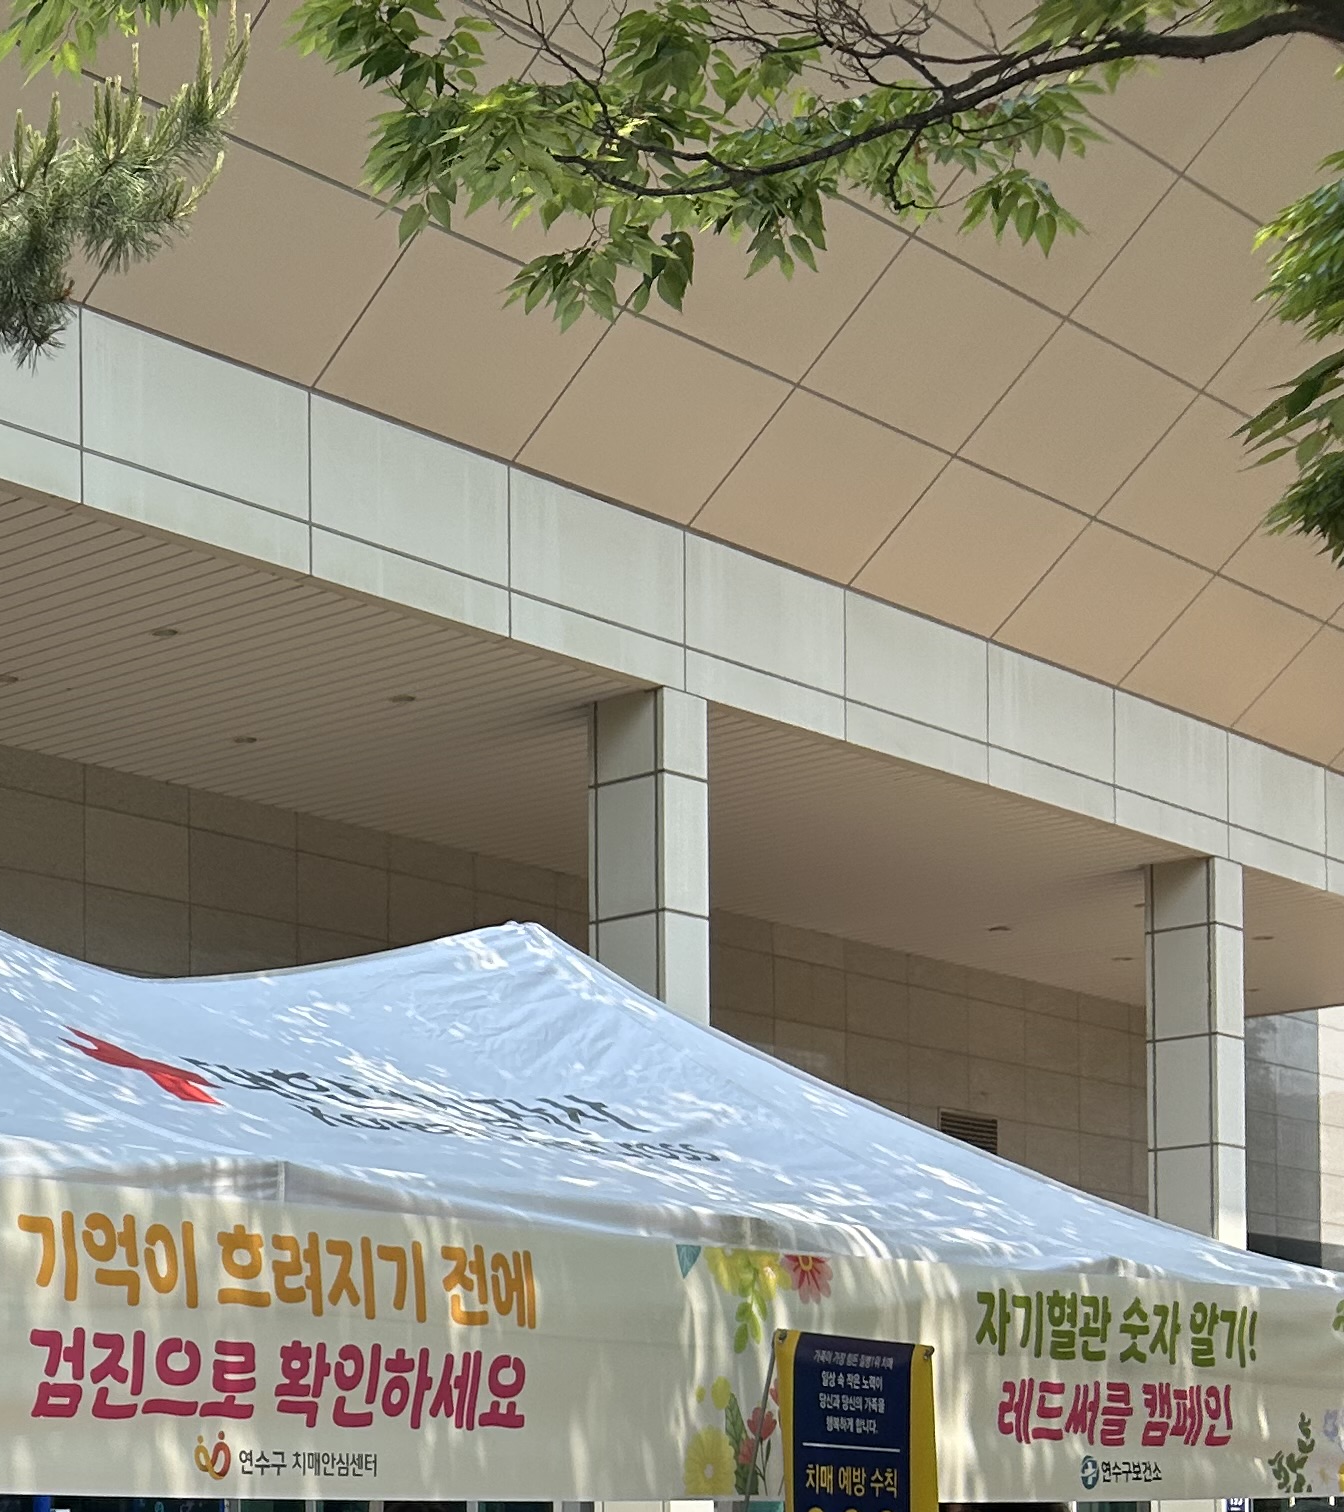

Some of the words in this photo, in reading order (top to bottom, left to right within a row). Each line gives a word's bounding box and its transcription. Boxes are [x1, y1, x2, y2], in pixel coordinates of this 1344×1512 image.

[18, 1210, 199, 1309] 기억이
[217, 1224, 427, 1324] 흐려지기
[441, 1244, 537, 1329] 전에
[975, 1288, 1111, 1361] 자기혈관
[1119, 1297, 1181, 1364] 숫자
[1189, 1302, 1257, 1368] 알기!
[29, 1326, 256, 1420] 검진으로
[274, 1340, 526, 1431] 확인하세요
[998, 1378, 1133, 1445] 레드써클
[1141, 1382, 1234, 1447] 캠페인
[238, 1450, 287, 1476] 연수구
[292, 1452, 378, 1477] 치매안심센터
[806, 1463, 834, 1496] 치매
[838, 1465, 867, 1497] 예방
[869, 1467, 898, 1498] 수칙
[1101, 1459, 1162, 1483] 연수구보건소
